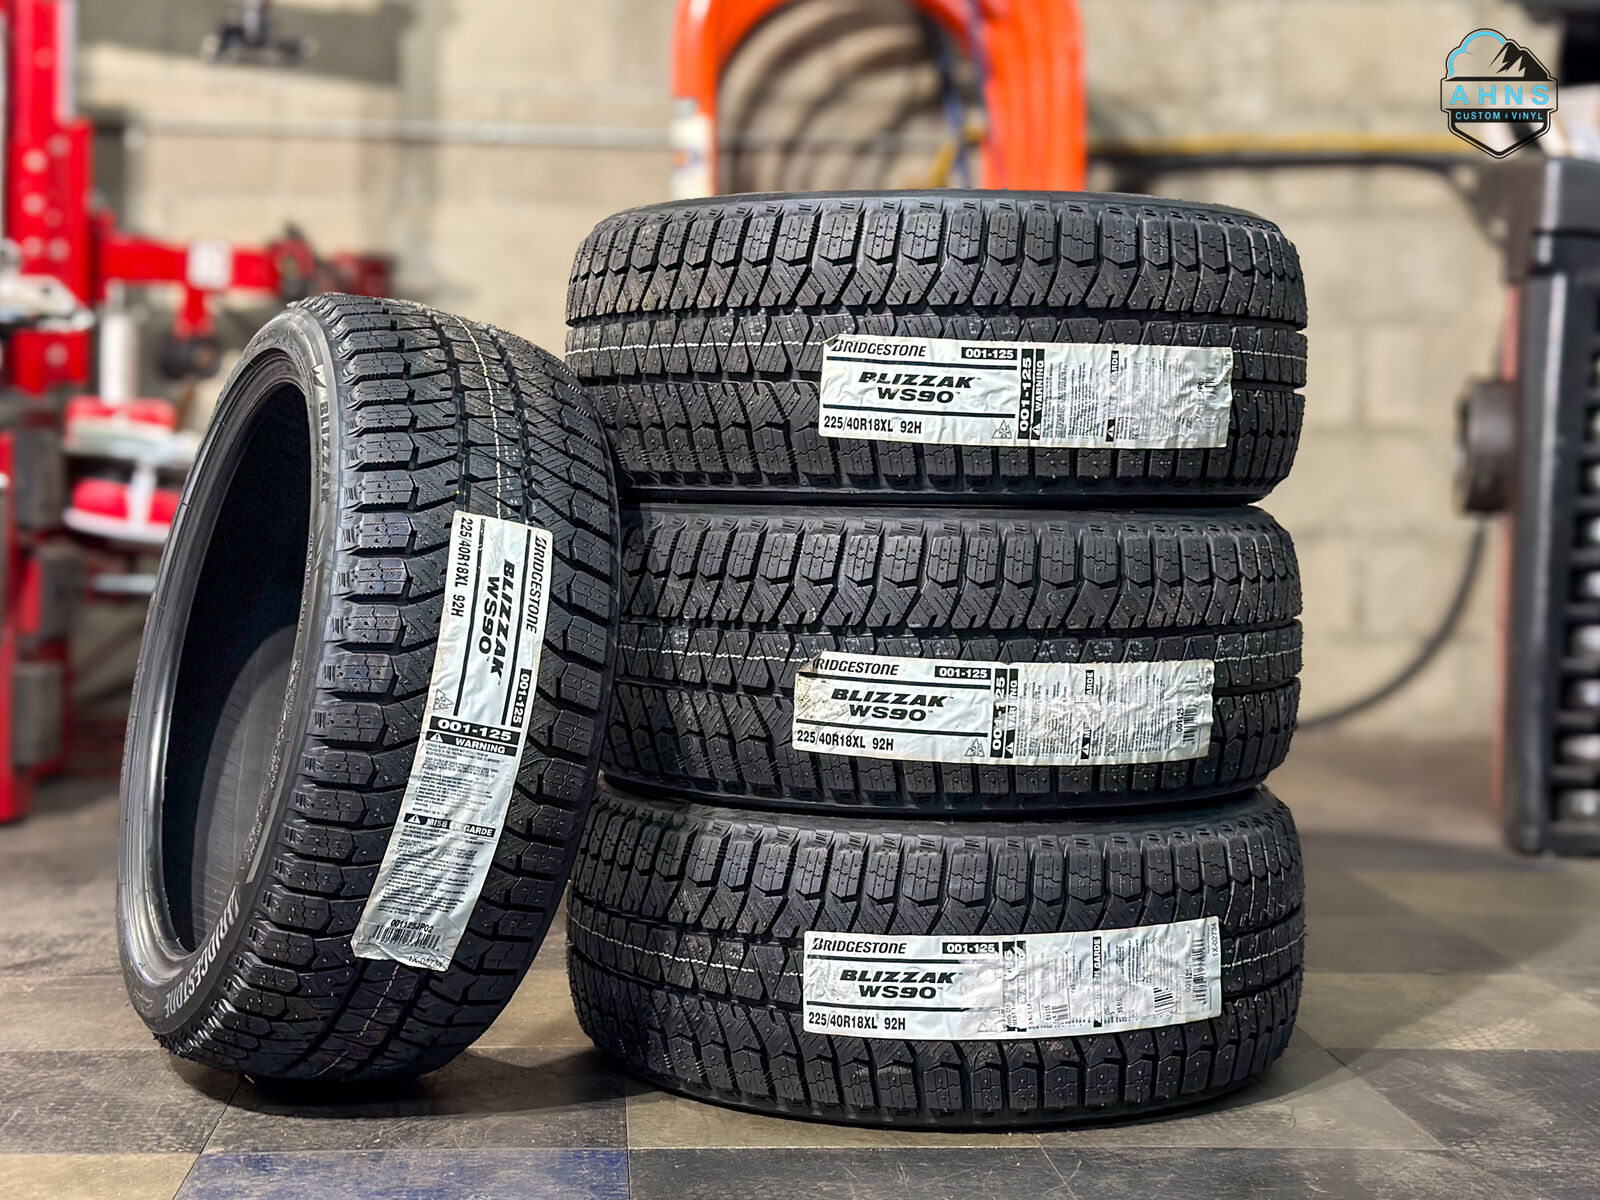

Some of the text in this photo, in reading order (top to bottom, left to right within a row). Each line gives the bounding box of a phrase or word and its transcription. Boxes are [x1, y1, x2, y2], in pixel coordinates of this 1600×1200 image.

[831, 339, 927, 357] BRIDGESTONE
[965, 348, 1014, 360] 001-125
[858, 371, 976, 389] BLIZZAK
[1034, 360, 1044, 411] WARNING
[877, 386, 955, 403] WS90
[1019, 356, 1032, 432] 001-125
[823, 415, 922, 434] 225/40R18XL 92H
[319, 400, 331, 503] BLIZZAK
[450, 517, 474, 617] 225/40R18XL 92H
[526, 535, 547, 634] BRIDGESTONE
[479, 576, 500, 655] WS90
[490, 559, 516, 679] BLIZZAK
[813, 658, 899, 676] RIDGESTONE
[939, 668, 988, 679] 001-125
[1085, 672, 1094, 695] ARDE
[512, 673, 530, 723] 001-125
[831, 688, 949, 708] BLIZZAK
[849, 704, 927, 722] WS90
[437, 719, 511, 741] 001-125
[455, 737, 506, 754] WARNING
[797, 730, 894, 751] 225/40R18XL 92H
[463, 824, 493, 836] GARDE
[390, 919, 434, 933] 001125JP02
[165, 885, 240, 1019] BRIDGESTONE
[812, 937, 908, 954] BRIDGESTONE
[947, 943, 996, 953] 001-125
[1093, 938, 1102, 968] GARDE
[839, 969, 958, 984] BLIZZAK
[859, 984, 937, 999] WS90
[808, 1011, 906, 1030] 225/40R18XL 92H
